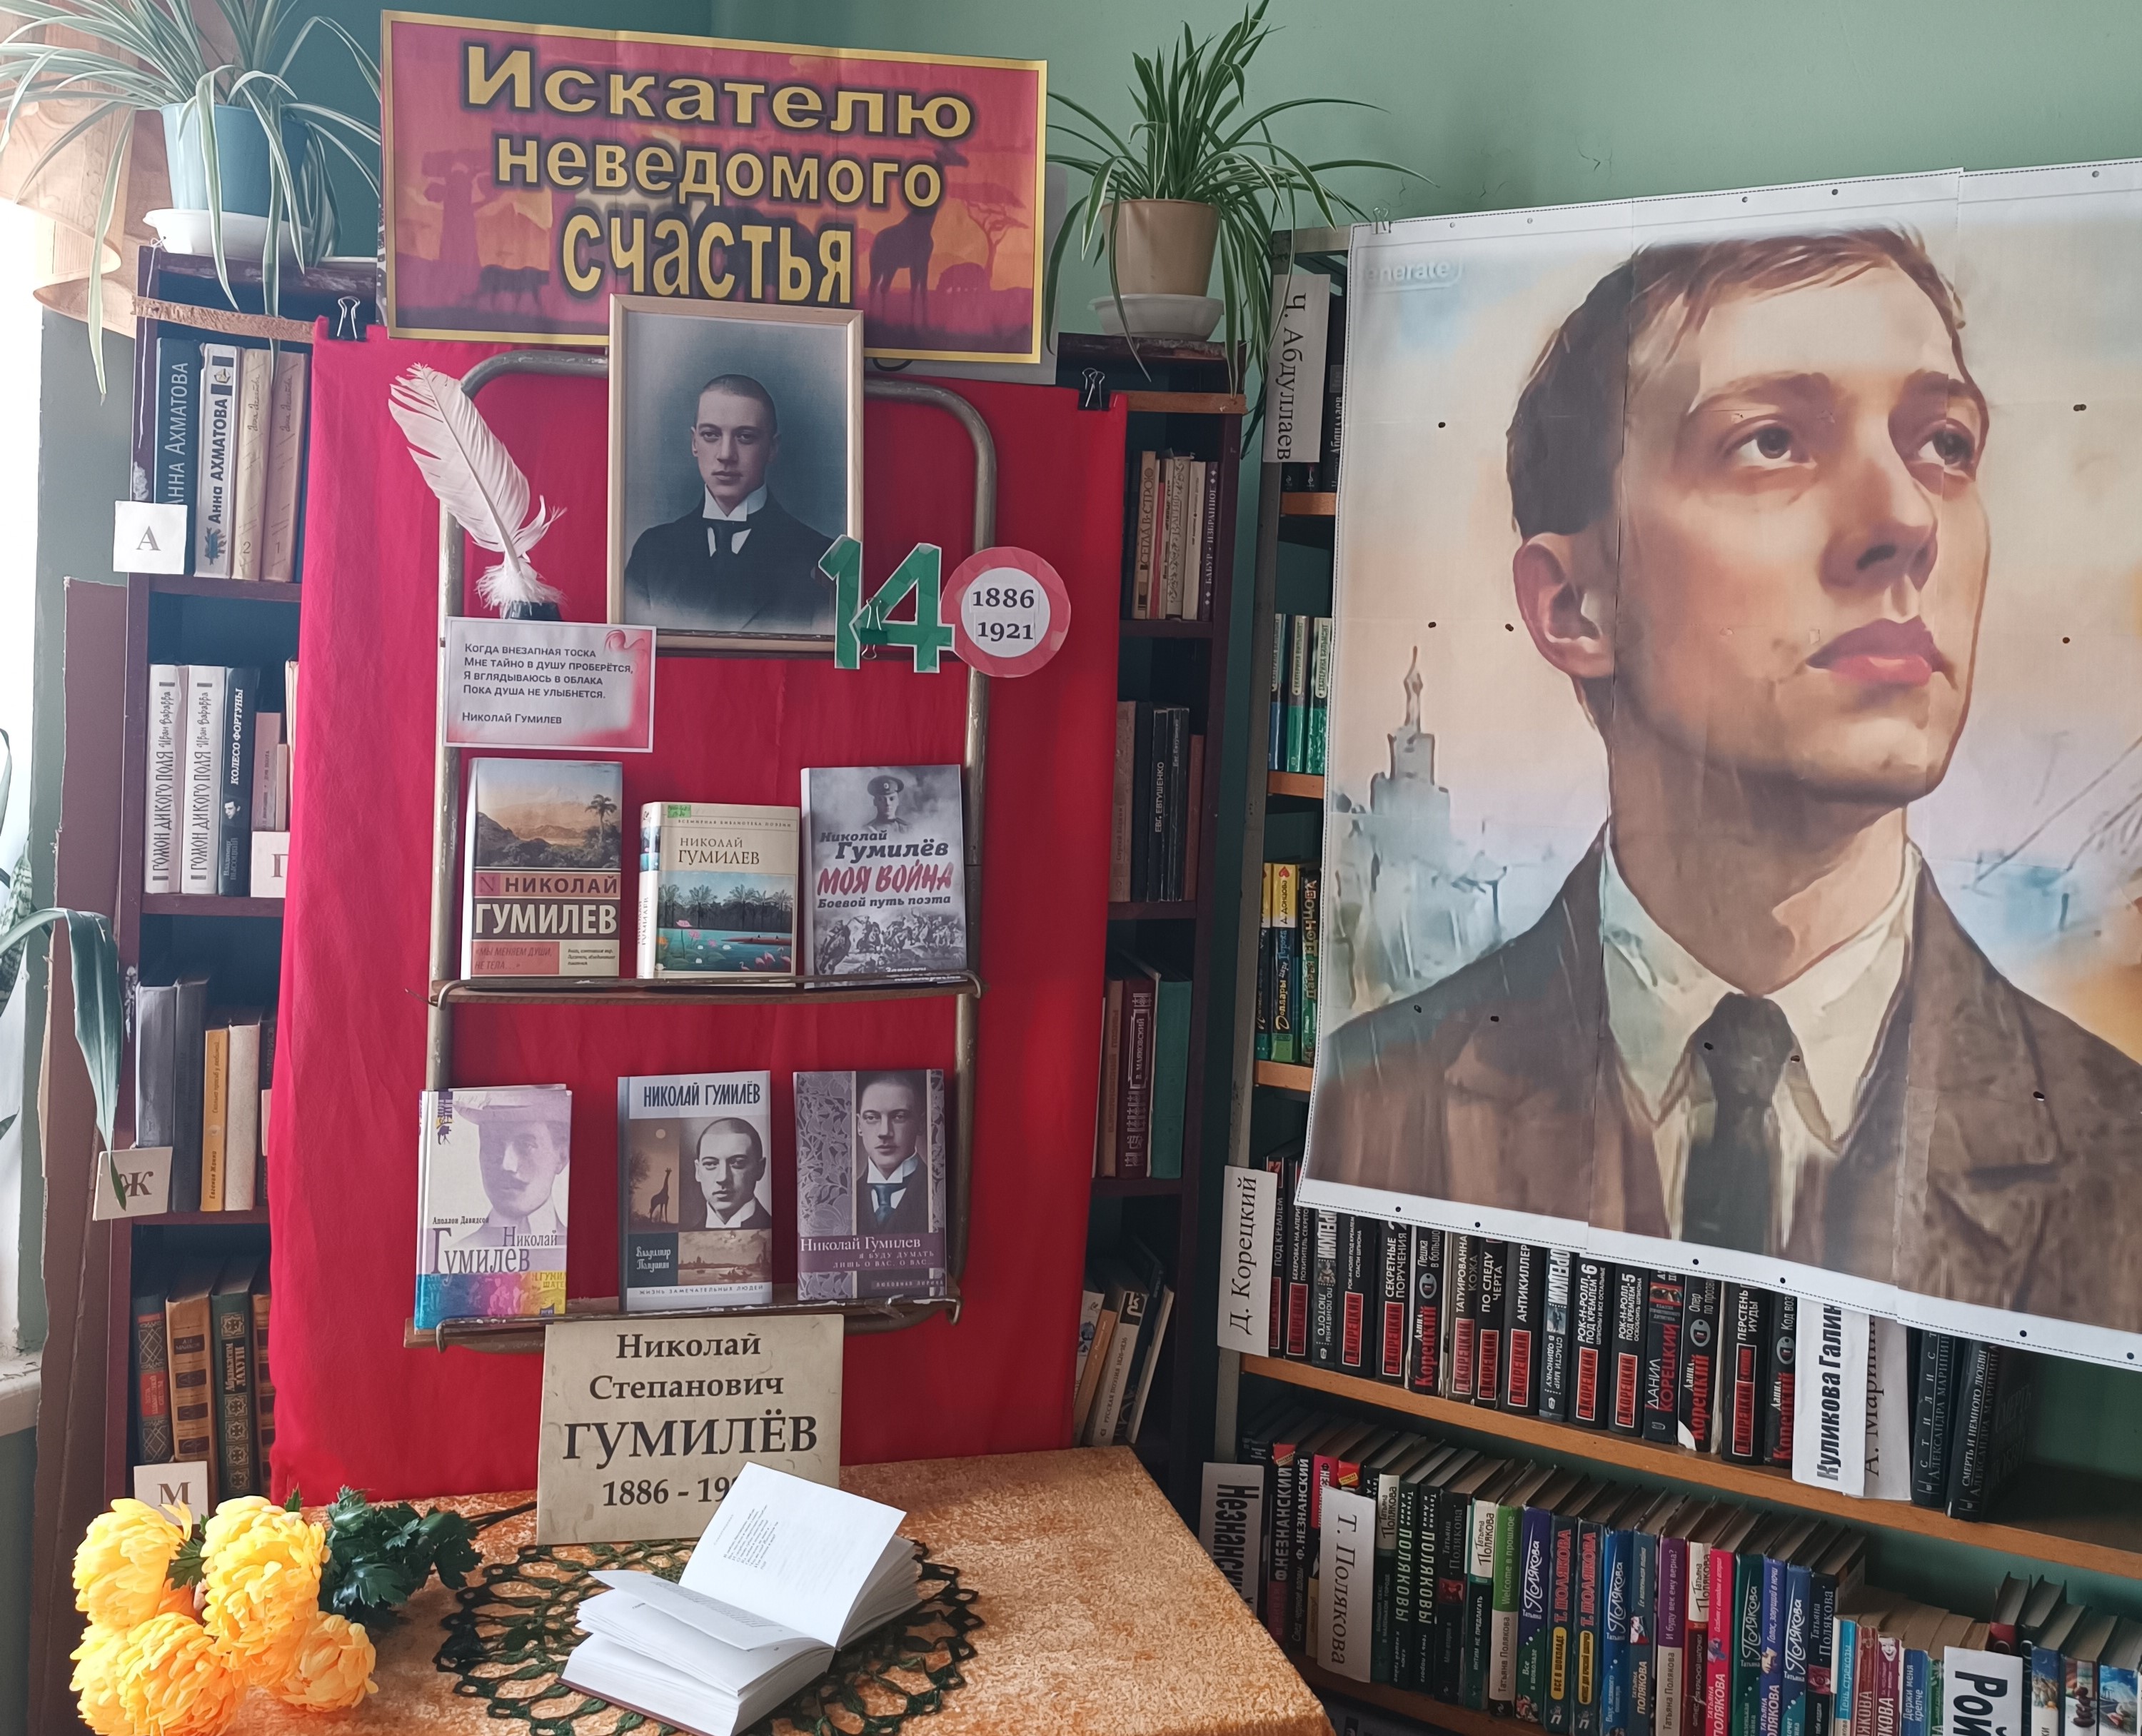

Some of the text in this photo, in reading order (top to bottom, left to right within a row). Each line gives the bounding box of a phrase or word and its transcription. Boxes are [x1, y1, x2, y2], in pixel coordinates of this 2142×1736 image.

[464, 44, 974, 139] Искателю
[496, 136, 943, 209] неведомого
[560, 214, 853, 303] счастья
[1276, 293, 1307, 461] Ч. Абдуллаев
[164, 362, 188, 455] АХМАТОВА
[208, 398, 228, 524] Анна АХМАТОВА
[136, 526, 161, 551] А
[242, 541, 251, 554] 2
[275, 541, 281, 554] 1
[972, 588, 1035, 608] 1886
[977, 622, 1034, 641] 1921
[463, 671, 471, 680] Я
[231, 688, 243, 786] КОЛЕСО ФОРТУНЫ
[1155, 761, 1165, 814] ЕВТУШЕНКО
[153, 751, 174, 871] ГОМОН ДИКОГО ПОЛЯ
[191, 751, 211, 870] ГОМОН ДИКОГО ПОЛЯ
[680, 836, 743, 848] НИКОЛАЙ
[820, 830, 888, 843] Николай
[835, 838, 949, 864] Гумилёв
[678, 849, 760, 866] ГУМИЛЕВ
[506, 875, 618, 894] НИКОЛАЙ
[817, 859, 954, 895] МОЯ ВОЙНА
[475, 903, 617, 935] ГУМИЛЕВ
[818, 895, 951, 909] Боевой путь поэта
[495, 946, 528, 957] МЕНЯЕМ
[643, 1080, 761, 1108] НИКОЛАЙ ГУМИЛЁВ
[116, 1170, 154, 1198] Ж
[502, 1226, 558, 1248] Николай
[800, 1236, 921, 1253] Николай Гумилев
[868, 1251, 892, 1260] БУДУ
[895, 1250, 935, 1259] ДУМАТЬ
[1417, 1240, 1429, 1267] Пешка
[430, 1227, 531, 1285] Гумилев
[1229, 1176, 1257, 1336] Д. Корецкий
[1384, 1237, 1397, 1298] СЕКРЕТНЫЕ
[1396, 1232, 1407, 1298] ПОРУЧЕНИЯ
[1456, 1235, 1468, 1313] ТАТУИРОВАННА
[1468, 1255, 1478, 1291] КОЖА
[668, 1286, 733, 1295] ЗАМЕЧАТЕЛЬНЫХ
[1326, 1288, 1333, 1300] ПО
[1482, 1251, 1493, 1313] ПО СЛЕДУ
[1492, 1265, 1503, 1301] ЧЕРТА
[1517, 1244, 1531, 1323] АНТИКИЛЛЕР
[1317, 1293, 1327, 1337] ЛЮТОГО
[1689, 1293, 1701, 1313] Опер
[1736, 1290, 1749, 1341] ПЕРСТЕНЬ
[1748, 1300, 1759, 1333] ИУДЫ
[615, 1333, 762, 1359] Николай
[1414, 1305, 1437, 1388] Корецкий
[1585, 1319, 1595, 1345] ПОД
[1554, 1337, 1563, 1368] СПАСТИ
[589, 1374, 785, 1400] Степанович
[1647, 1358, 1661, 1410] ДАНИЛ
[1919, 1330, 1938, 1469] СТИЛИСТ
[1816, 1372, 1841, 1481] Куликова
[1961, 1349, 1987, 1487] СМЕРТЬ И НЕМНОГО ЛЮБВИ
[562, 1408, 818, 1470] ГУМИЛЁВ
[1928, 1401, 1946, 1480] АЛЕКСАНДРА
[1864, 1447, 1880, 1477] А.
[156, 1481, 191, 1507] М
[603, 1477, 670, 1507] 1886
[1295, 1458, 1309, 1560] Ф. НЕЗНАНСКИЙ
[1337, 1513, 1357, 1534] Т.
[1506, 1515, 1516, 1557] прошлое
[1395, 1528, 1413, 1622] ПОЛЯКОВЫ
[1418, 1531, 1436, 1625] ПОЛЯКОВЫ
[1501, 1567, 1512, 1605] Welcome
[1554, 1529, 1572, 1624] Т. ПОЛЯКОВА
[1581, 1532, 1597, 1612] ПОЛЯКОВА
[1580, 1613, 1594, 1627] Т.
[1810, 1602, 1821, 1640] Татьяна
[1819, 1590, 1834, 1657] Полякова
[1498, 1616, 1510, 1694] Татьяна Полякова
[1663, 1652, 1675, 1732] Татьяна Полякова
[1839, 1644, 1852, 1713] Тень стрекозы
[1902, 1697, 1914, 1721] Держи
[1914, 1689, 1924, 1722] крепче
